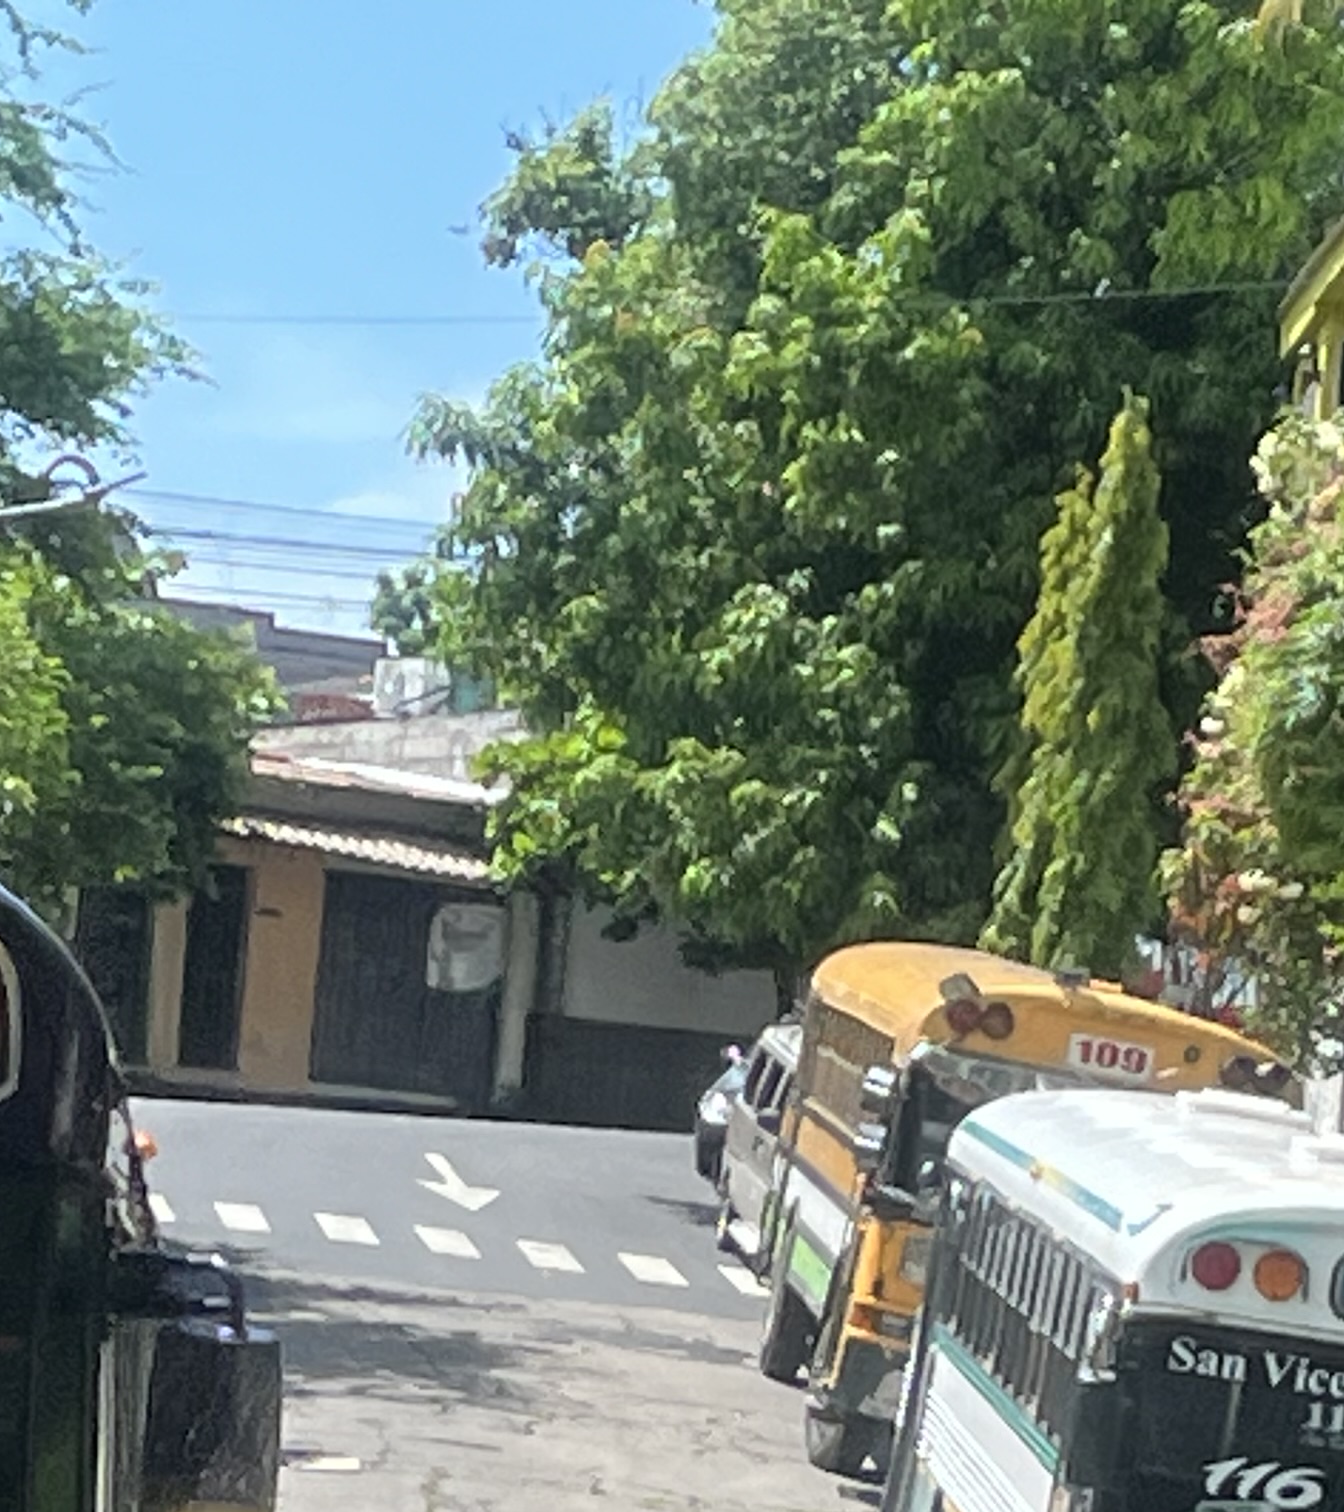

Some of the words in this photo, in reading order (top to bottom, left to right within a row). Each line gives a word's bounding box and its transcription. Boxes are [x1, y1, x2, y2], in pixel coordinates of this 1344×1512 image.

[1076, 1040, 1147, 1074] 109
[1167, 1336, 1248, 1382] San
[1203, 1456, 1326, 1510] 116
